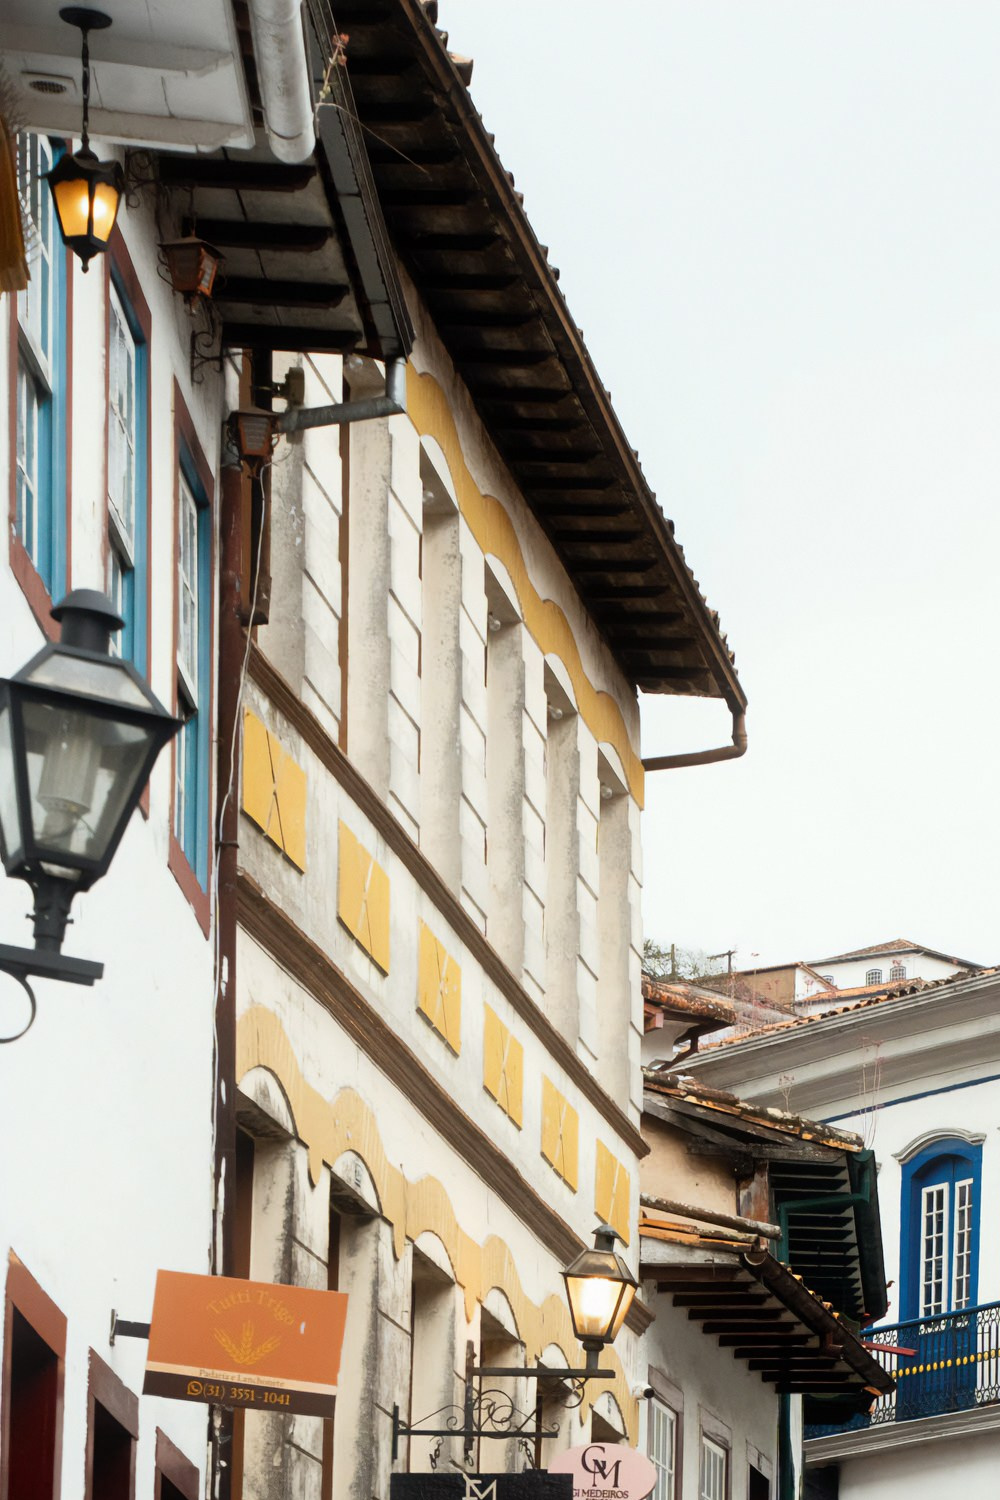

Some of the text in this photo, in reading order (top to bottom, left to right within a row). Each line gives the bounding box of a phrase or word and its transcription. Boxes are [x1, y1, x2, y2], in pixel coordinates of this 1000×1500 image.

[207, 1289, 295, 1326] Tutti Trigo
[203, 1382, 226, 1401] (31)
[581, 1489, 630, 1499] MEDEIROS
